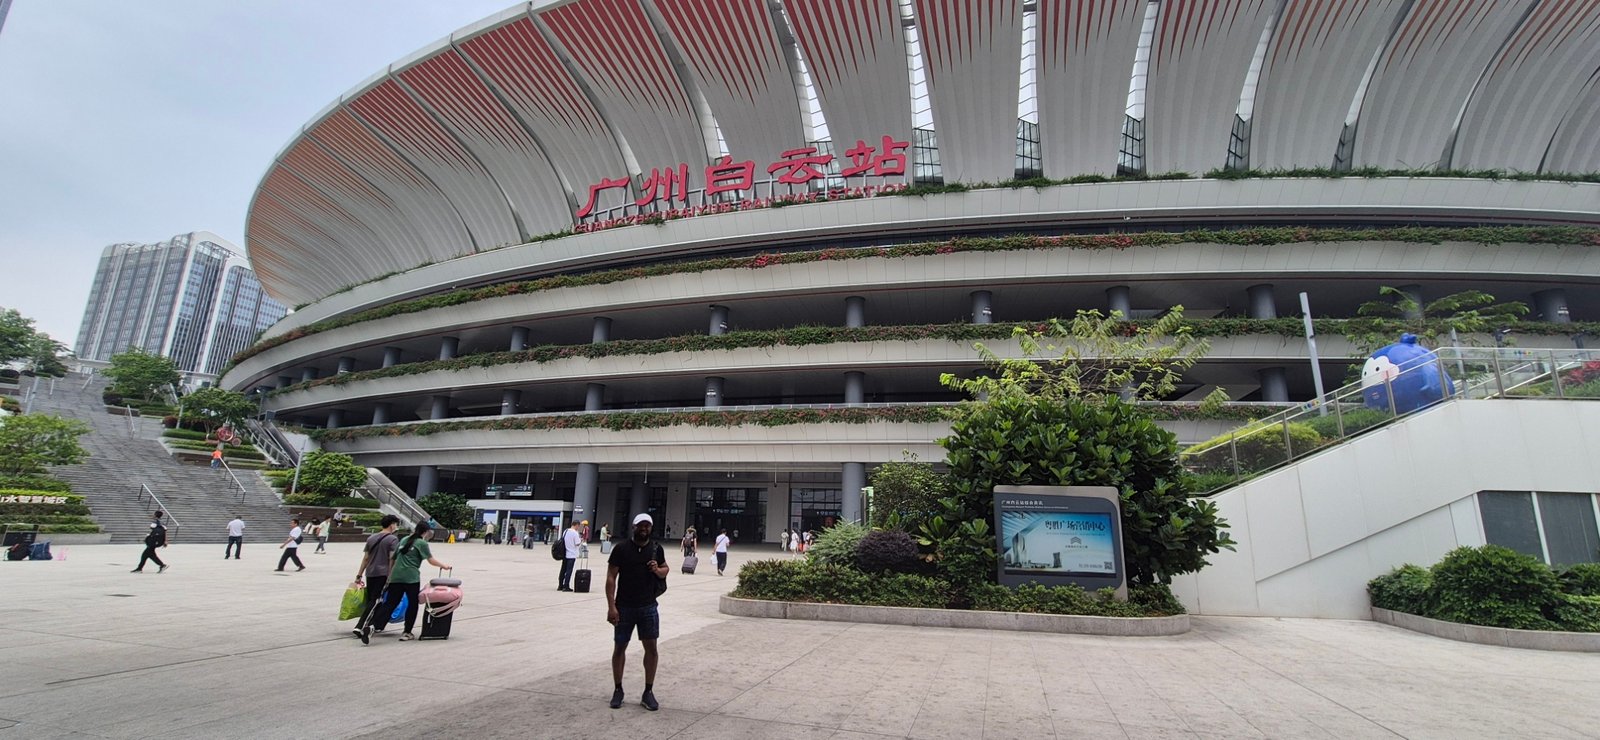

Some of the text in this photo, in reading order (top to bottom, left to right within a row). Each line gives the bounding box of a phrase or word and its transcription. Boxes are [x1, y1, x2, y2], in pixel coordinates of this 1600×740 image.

[575, 135, 910, 218] 广州白云站
[826, 182, 908, 202] STATION
